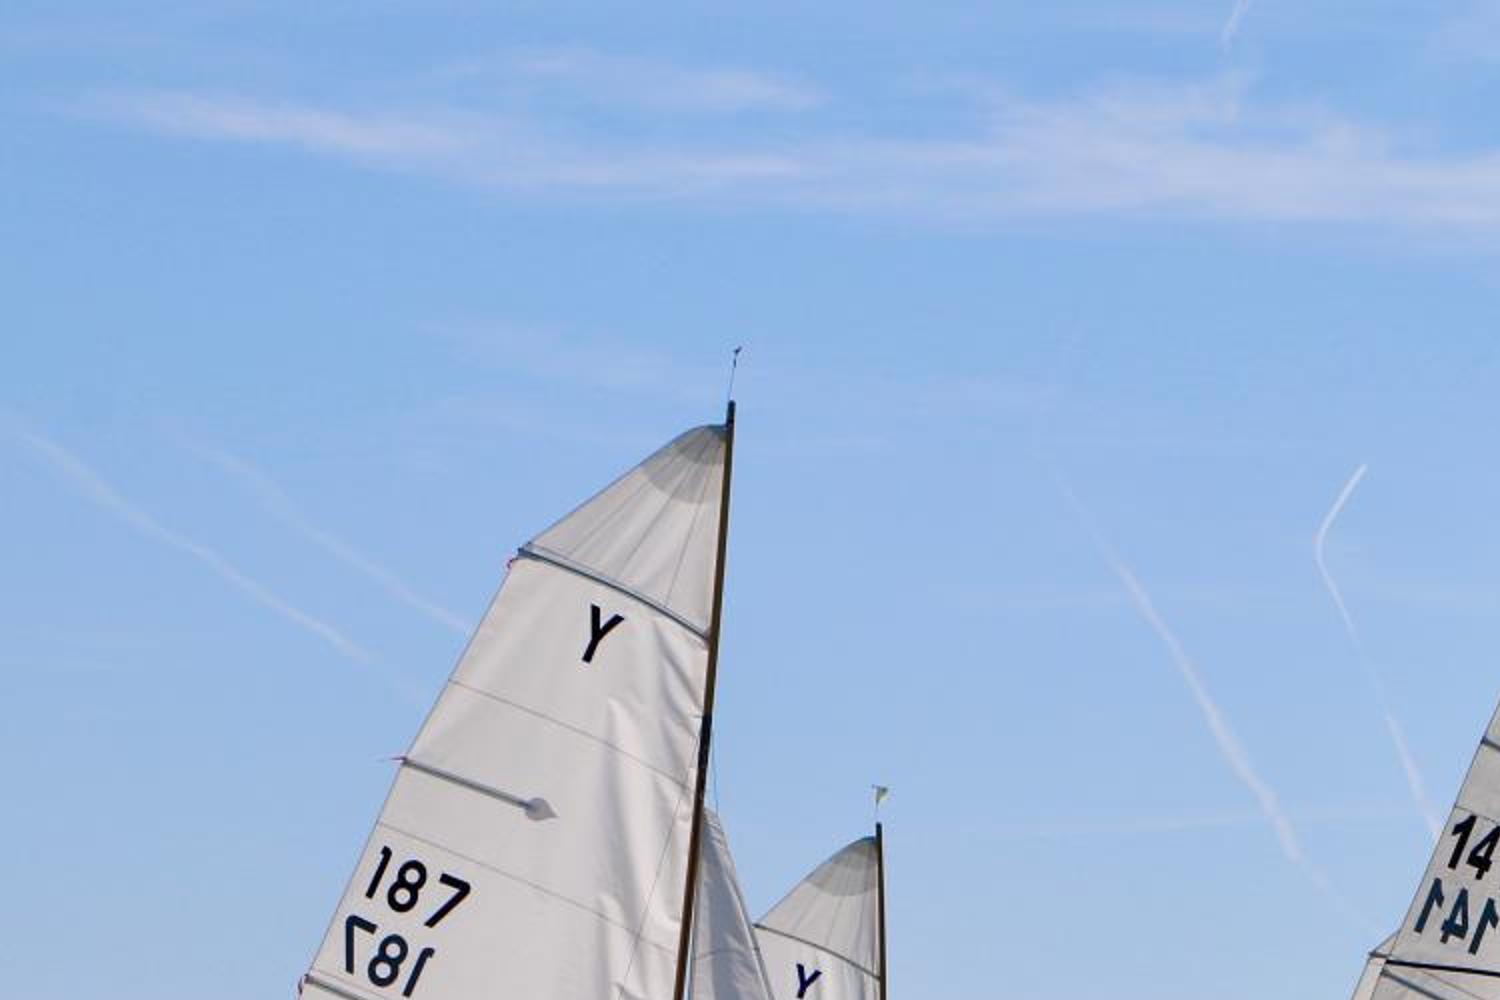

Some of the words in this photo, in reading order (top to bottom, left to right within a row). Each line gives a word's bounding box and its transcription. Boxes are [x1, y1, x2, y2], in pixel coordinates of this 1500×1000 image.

[581, 603, 625, 664] Y
[365, 845, 472, 929] 187
[796, 963, 823, 1000] Y
